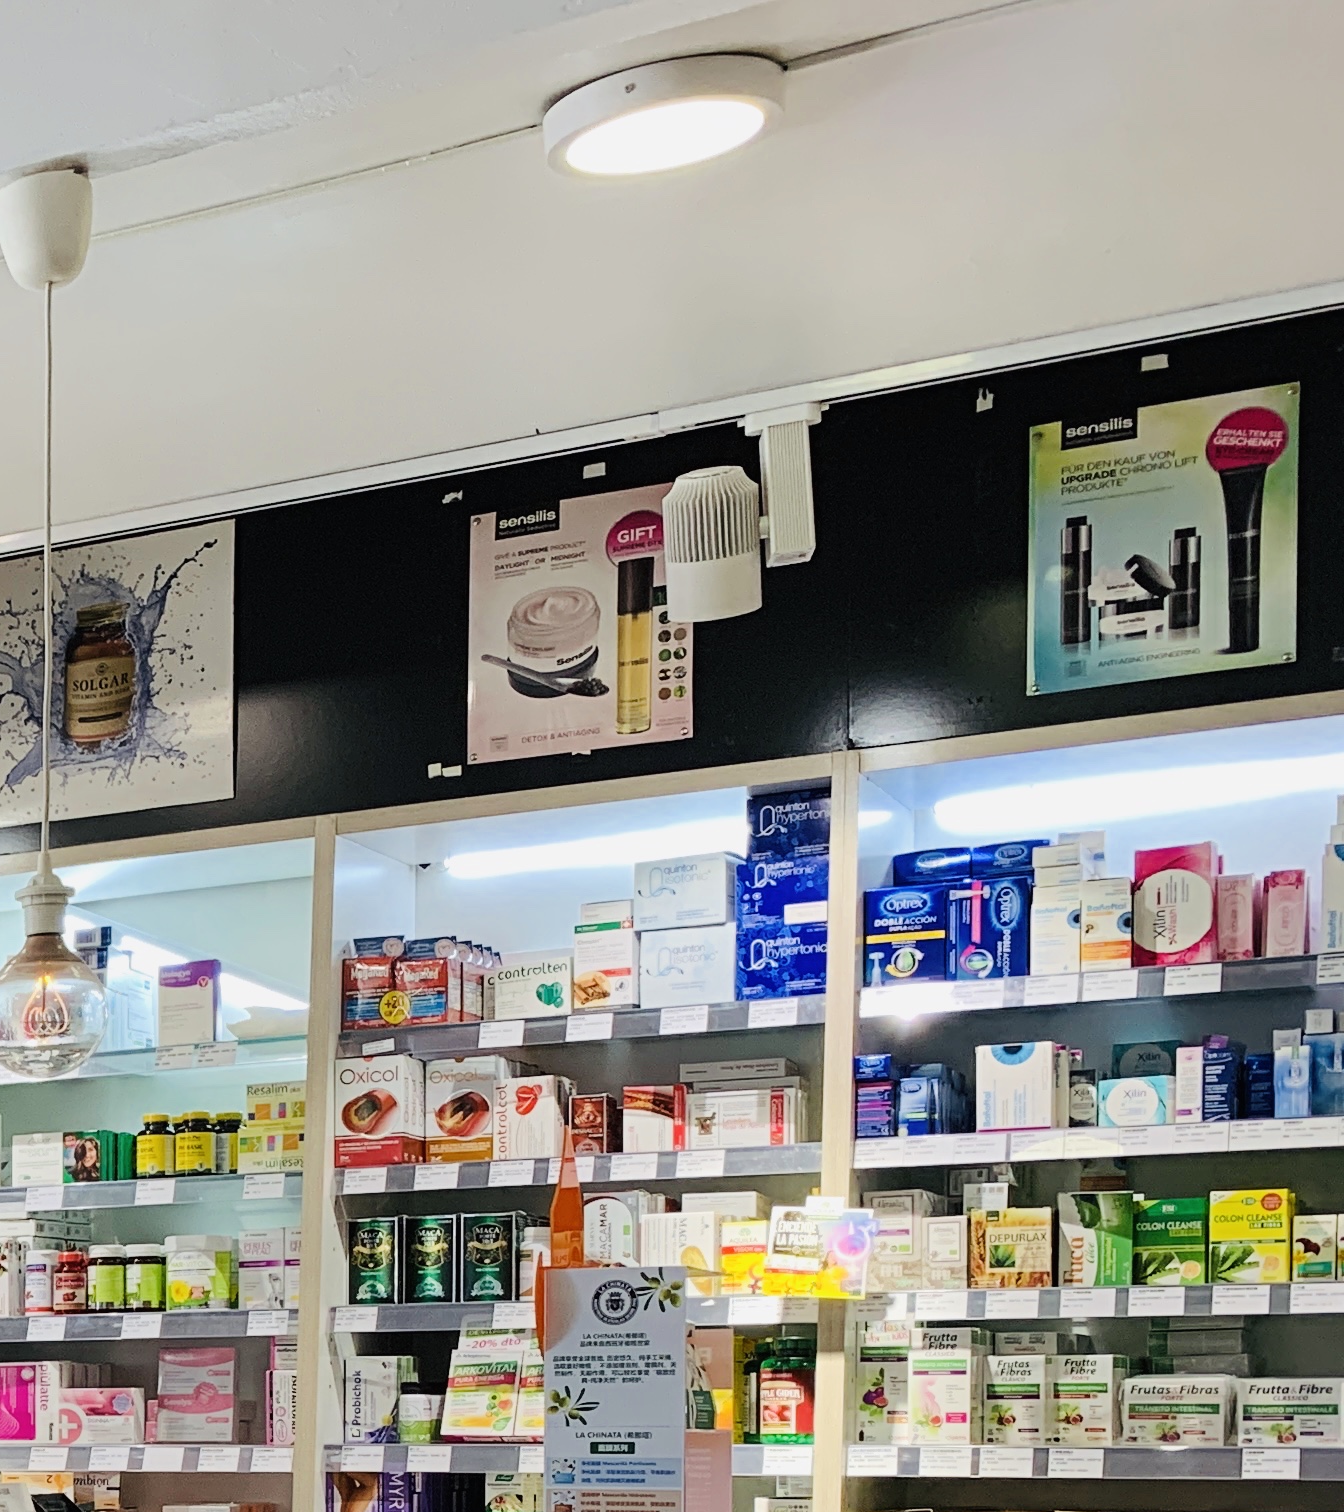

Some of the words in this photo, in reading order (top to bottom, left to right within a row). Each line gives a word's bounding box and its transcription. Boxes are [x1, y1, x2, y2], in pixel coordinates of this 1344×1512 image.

[1066, 417, 1133, 438] sensilis
[1087, 460, 1112, 472] DEN
[1113, 455, 1146, 468] KAUF
[1149, 450, 1176, 462] VON
[1061, 469, 1117, 485] UPGRADE
[1119, 462, 1172, 476] CHRONO
[499, 509, 557, 529] sensilis
[617, 526, 657, 544] GIFT
[72, 672, 130, 692] SOLGAR
[886, 897, 925, 914] Optrex
[497, 959, 568, 981] controlten
[339, 1065, 399, 1085] Oxicol
[247, 1083, 289, 1096] Resalim
[1136, 1222, 1166, 1232] COLON
[1167, 1220, 1203, 1231] CLEANSE
[1214, 1213, 1245, 1224] COLON
[1246, 1212, 1283, 1223] CLEANSE
[989, 1230, 1048, 1245] DEPURLAX
[922, 1331, 958, 1343] Frutta
[454, 1360, 518, 1377] ARKOVITAL
[996, 1359, 1031, 1371] Frutas
